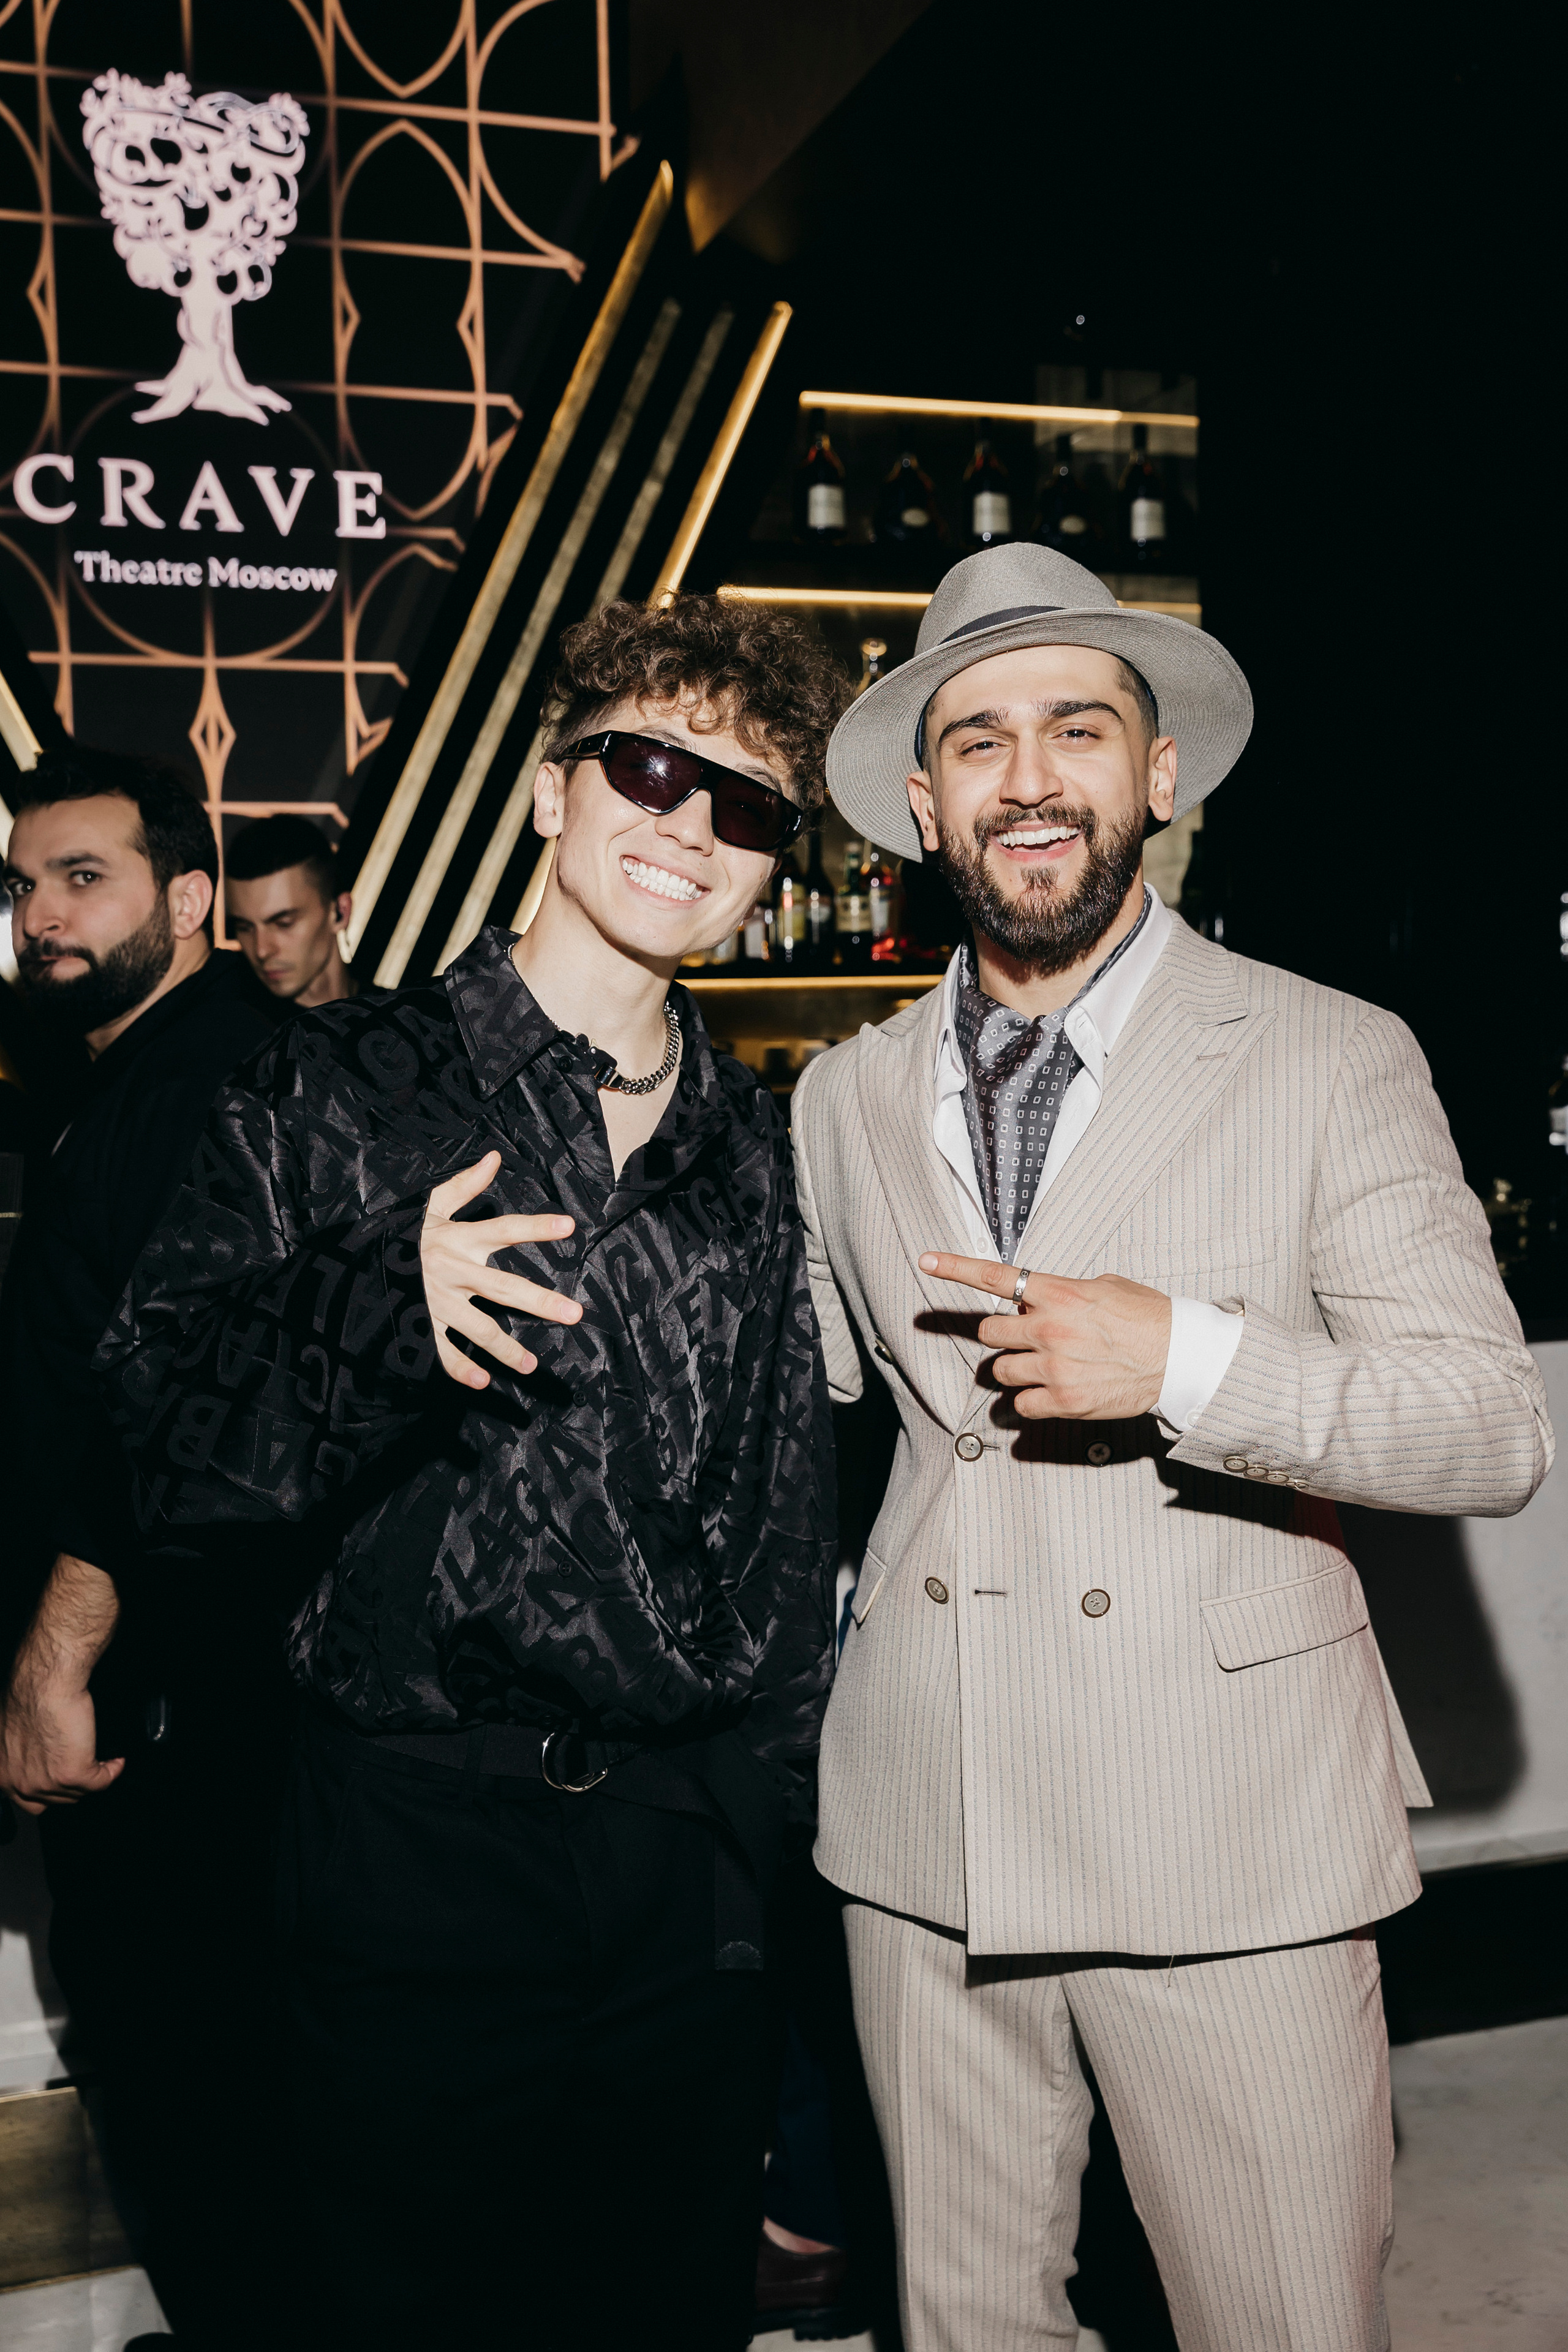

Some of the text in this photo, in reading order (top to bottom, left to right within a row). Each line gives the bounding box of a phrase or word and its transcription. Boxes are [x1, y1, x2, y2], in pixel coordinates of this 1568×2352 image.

[13, 453, 386, 539] CRAVE
[74, 550, 337, 592] Theatre Moscow
